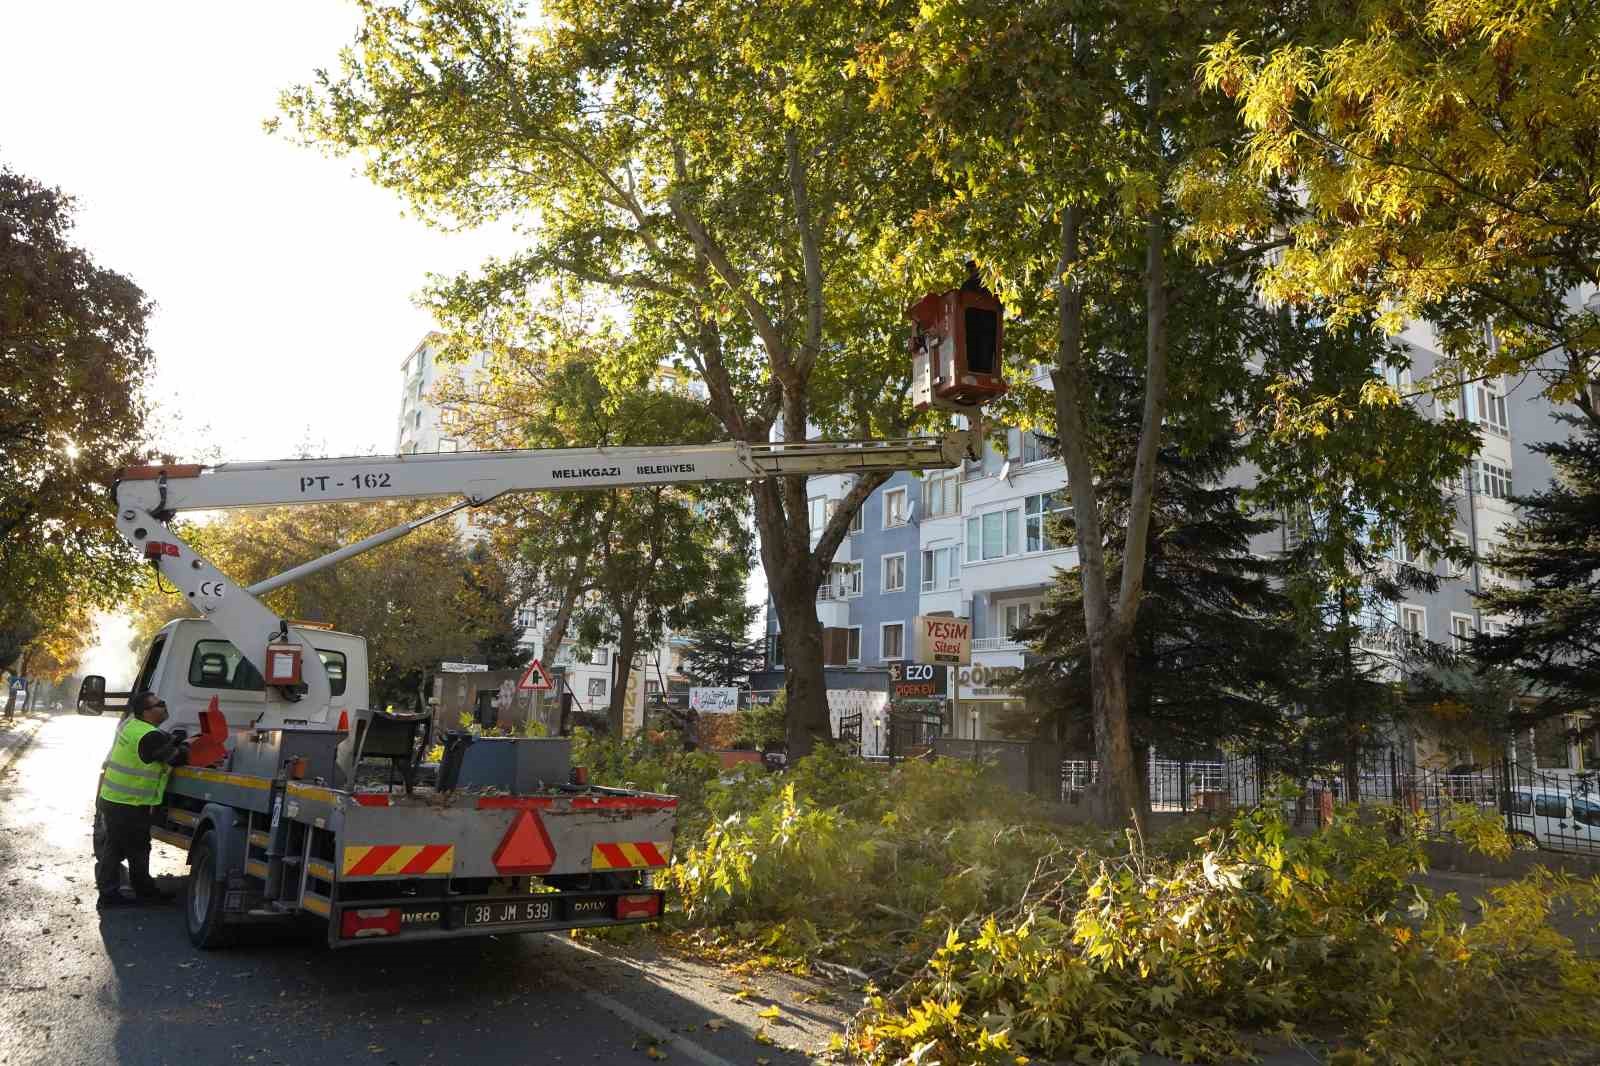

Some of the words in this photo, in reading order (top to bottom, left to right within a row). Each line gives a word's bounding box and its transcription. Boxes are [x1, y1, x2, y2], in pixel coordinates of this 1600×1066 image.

[300, 475, 330, 493] PT
[351, 473, 392, 489] 162
[933, 640, 961, 654] Sitesi
[906, 664, 933, 680] EZO
[475, 906, 491, 922] 38
[500, 904, 518, 921] JM
[527, 902, 549, 919] 539
[574, 901, 607, 912] DAILY
[401, 911, 440, 923] IVECO
